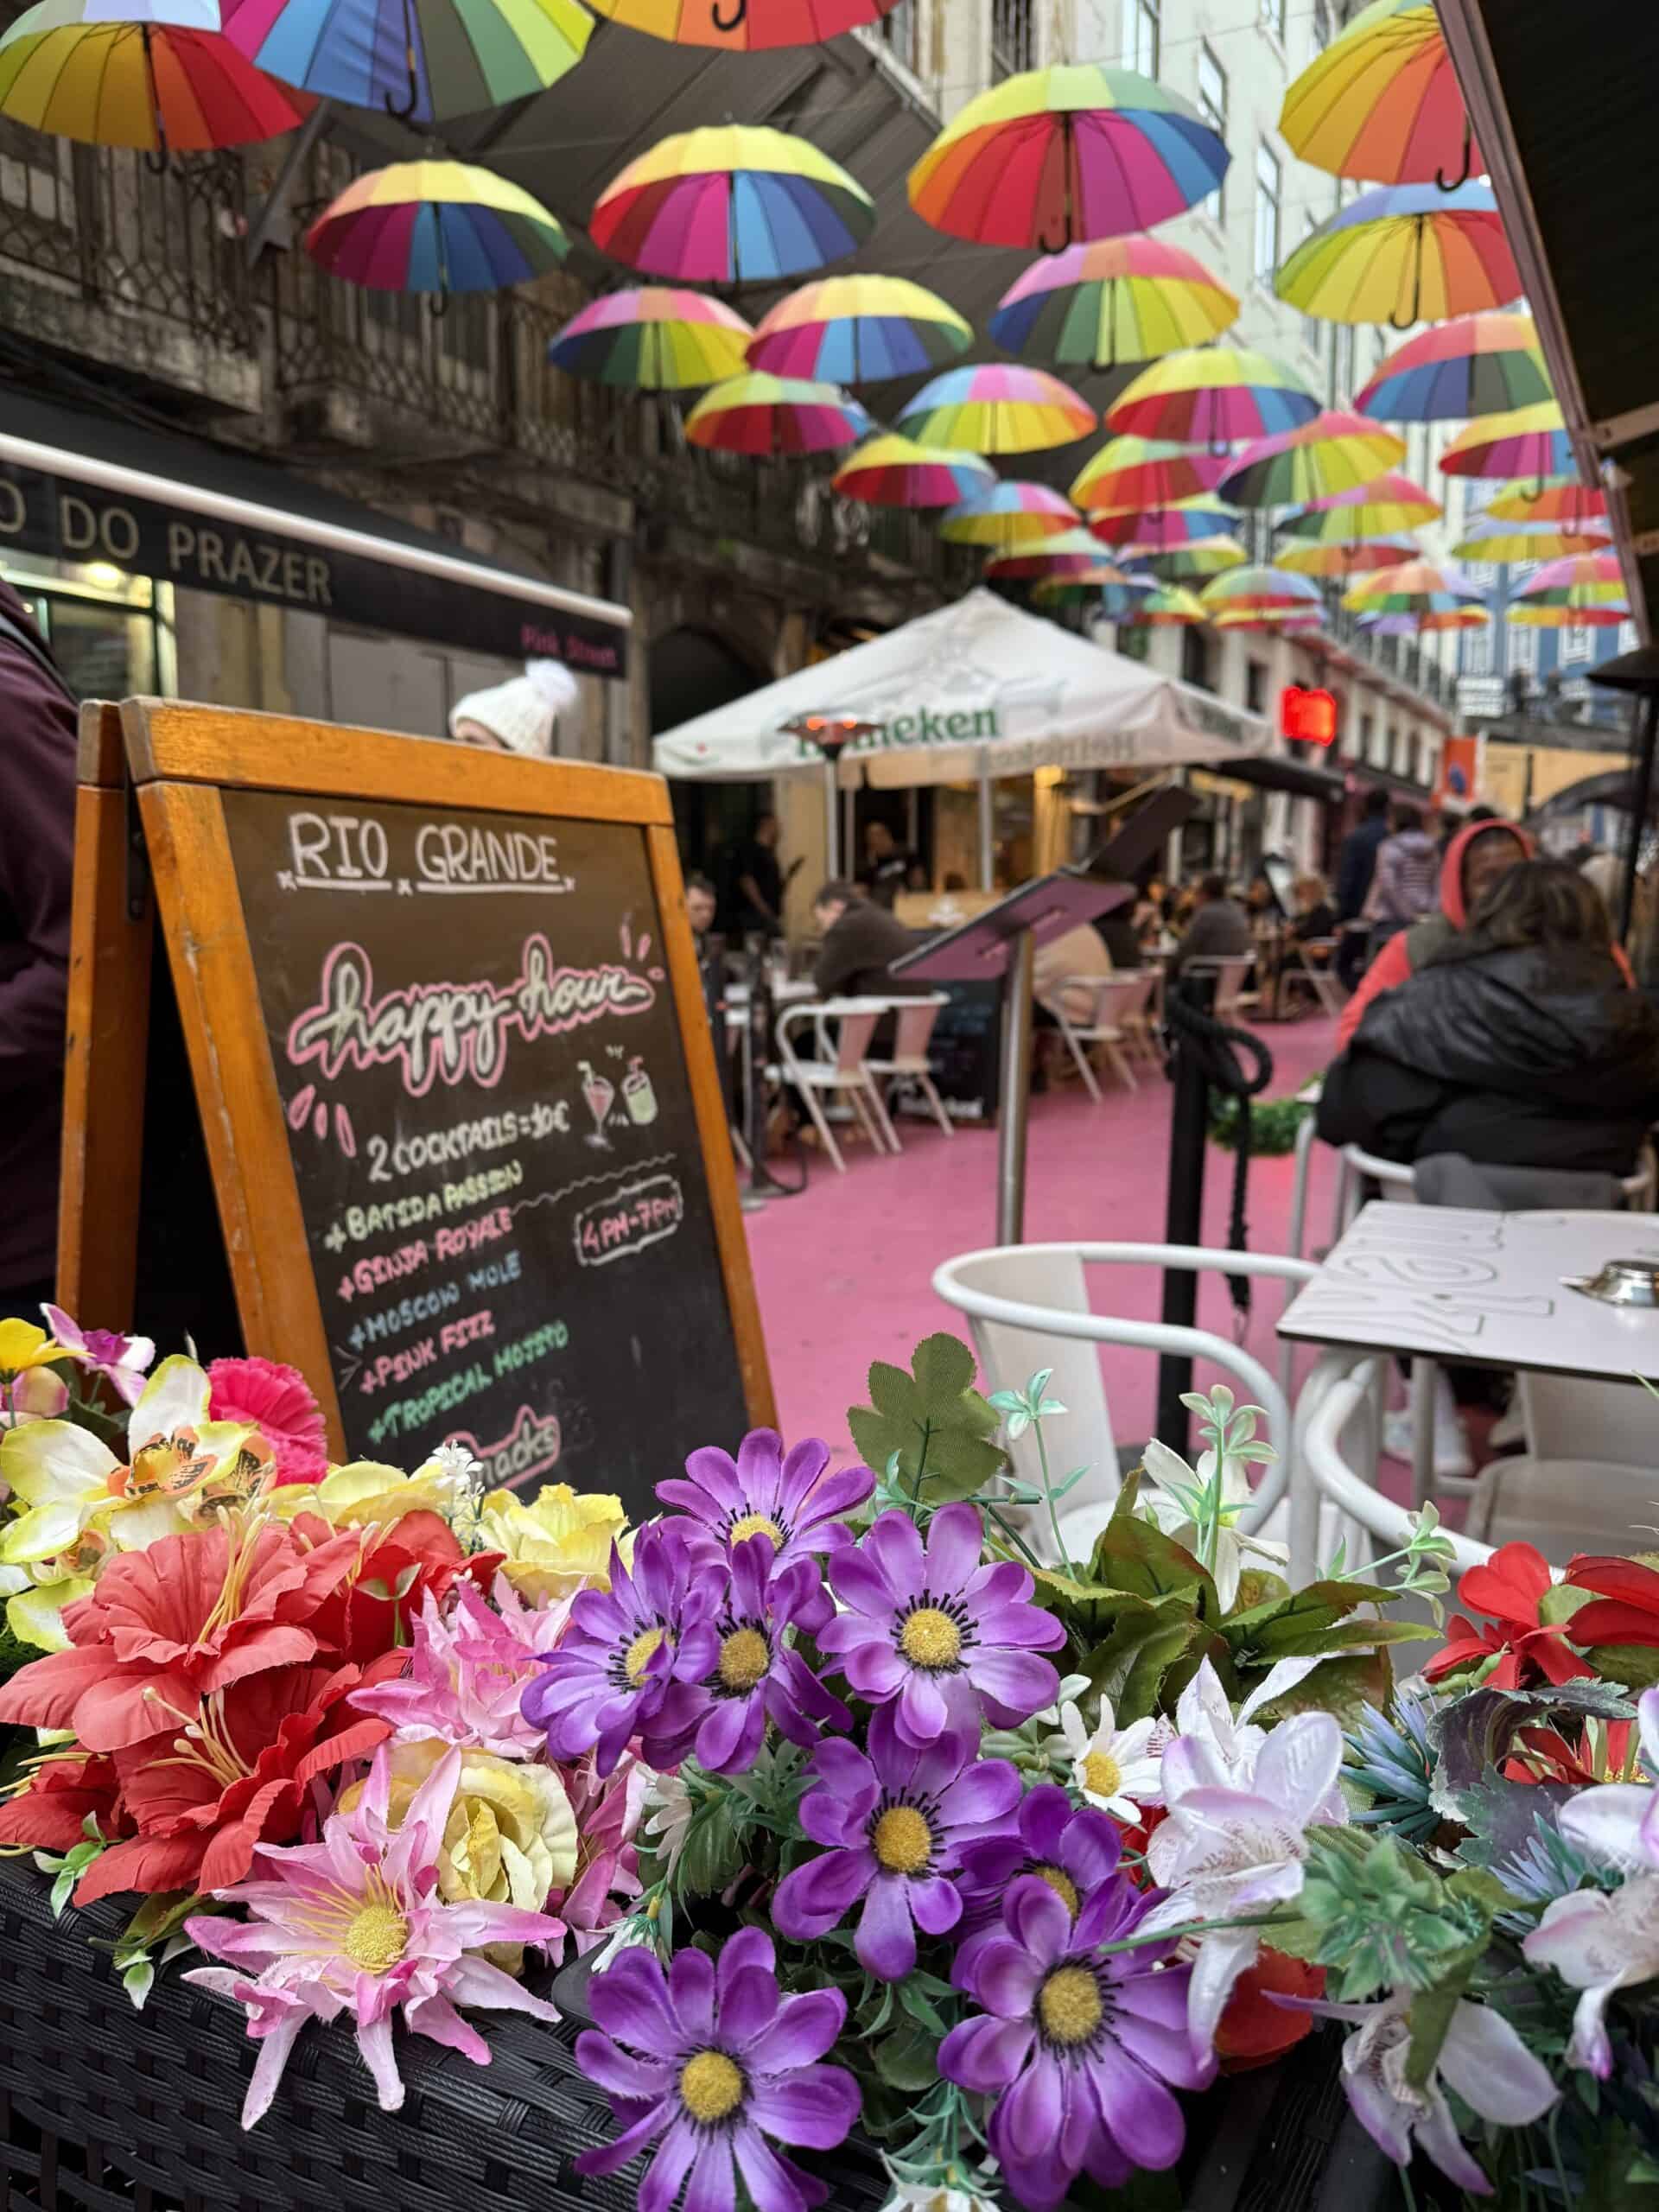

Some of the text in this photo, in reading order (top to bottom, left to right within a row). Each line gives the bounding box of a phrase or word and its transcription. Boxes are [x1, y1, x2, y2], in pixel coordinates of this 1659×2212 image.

[60, 495, 139, 560] DO
[168, 523, 333, 605] PRAZER
[287, 811, 561, 883] RIO GRANDE
[298, 947, 648, 1084] happy hour
[366, 1135, 392, 1183] 2
[346, 1192, 442, 1241] BATIDA
[435, 1205, 513, 1262] ROYALE
[365, 1281, 461, 1342] MOSCOW
[374, 1309, 496, 1387] PINK FIZZ
[382, 1362, 493, 1438] TROPICAL
[469, 1421, 555, 1495] nacks
